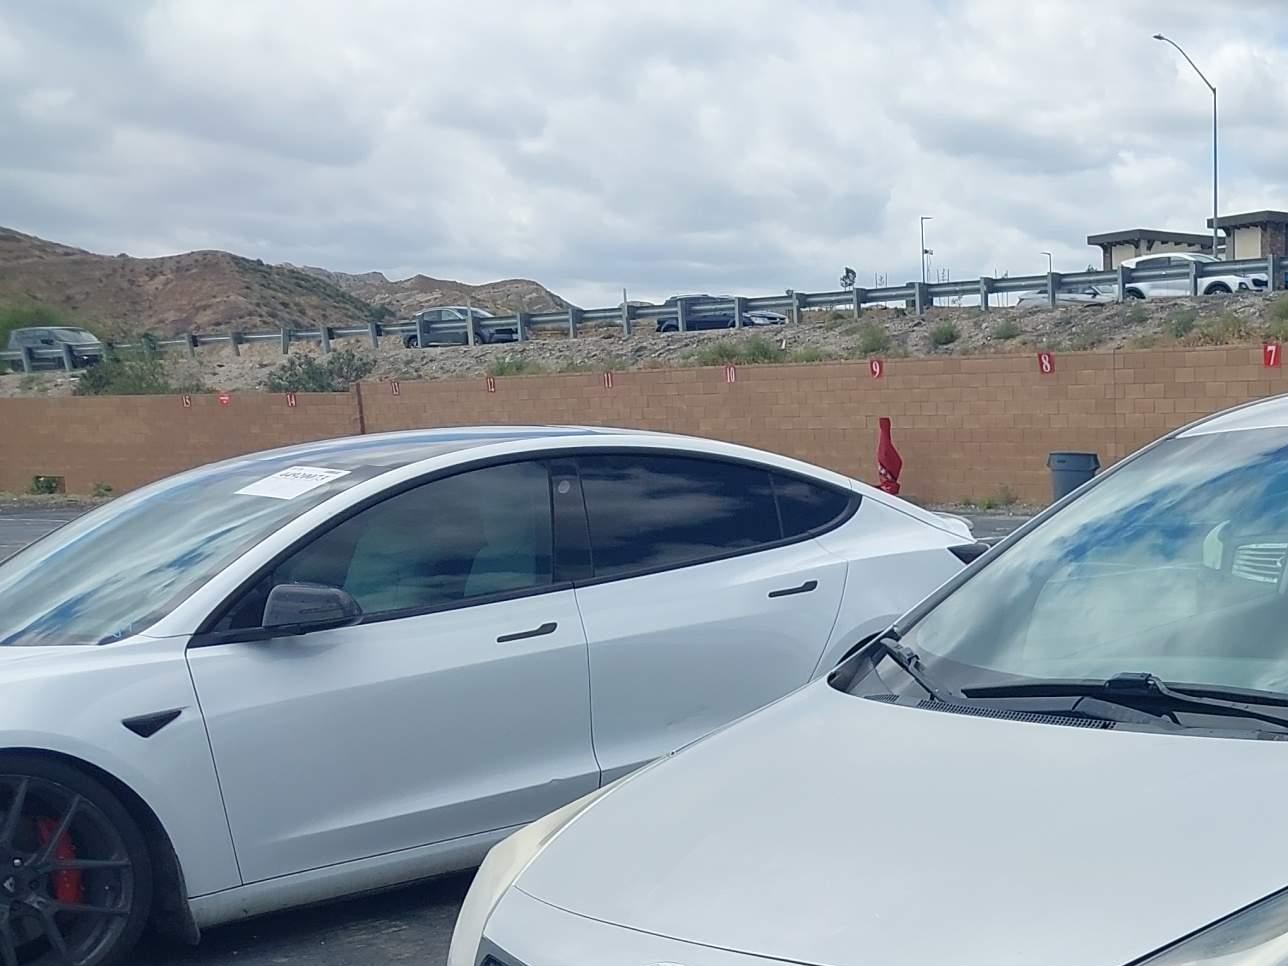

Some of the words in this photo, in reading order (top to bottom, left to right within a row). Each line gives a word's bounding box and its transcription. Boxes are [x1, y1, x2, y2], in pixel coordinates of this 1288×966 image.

[1041, 353, 1051, 373] 8
[1266, 345, 1277, 366] 7
[726, 366, 736, 383] 10
[872, 360, 880, 378] 9
[603, 373, 612, 388] 11
